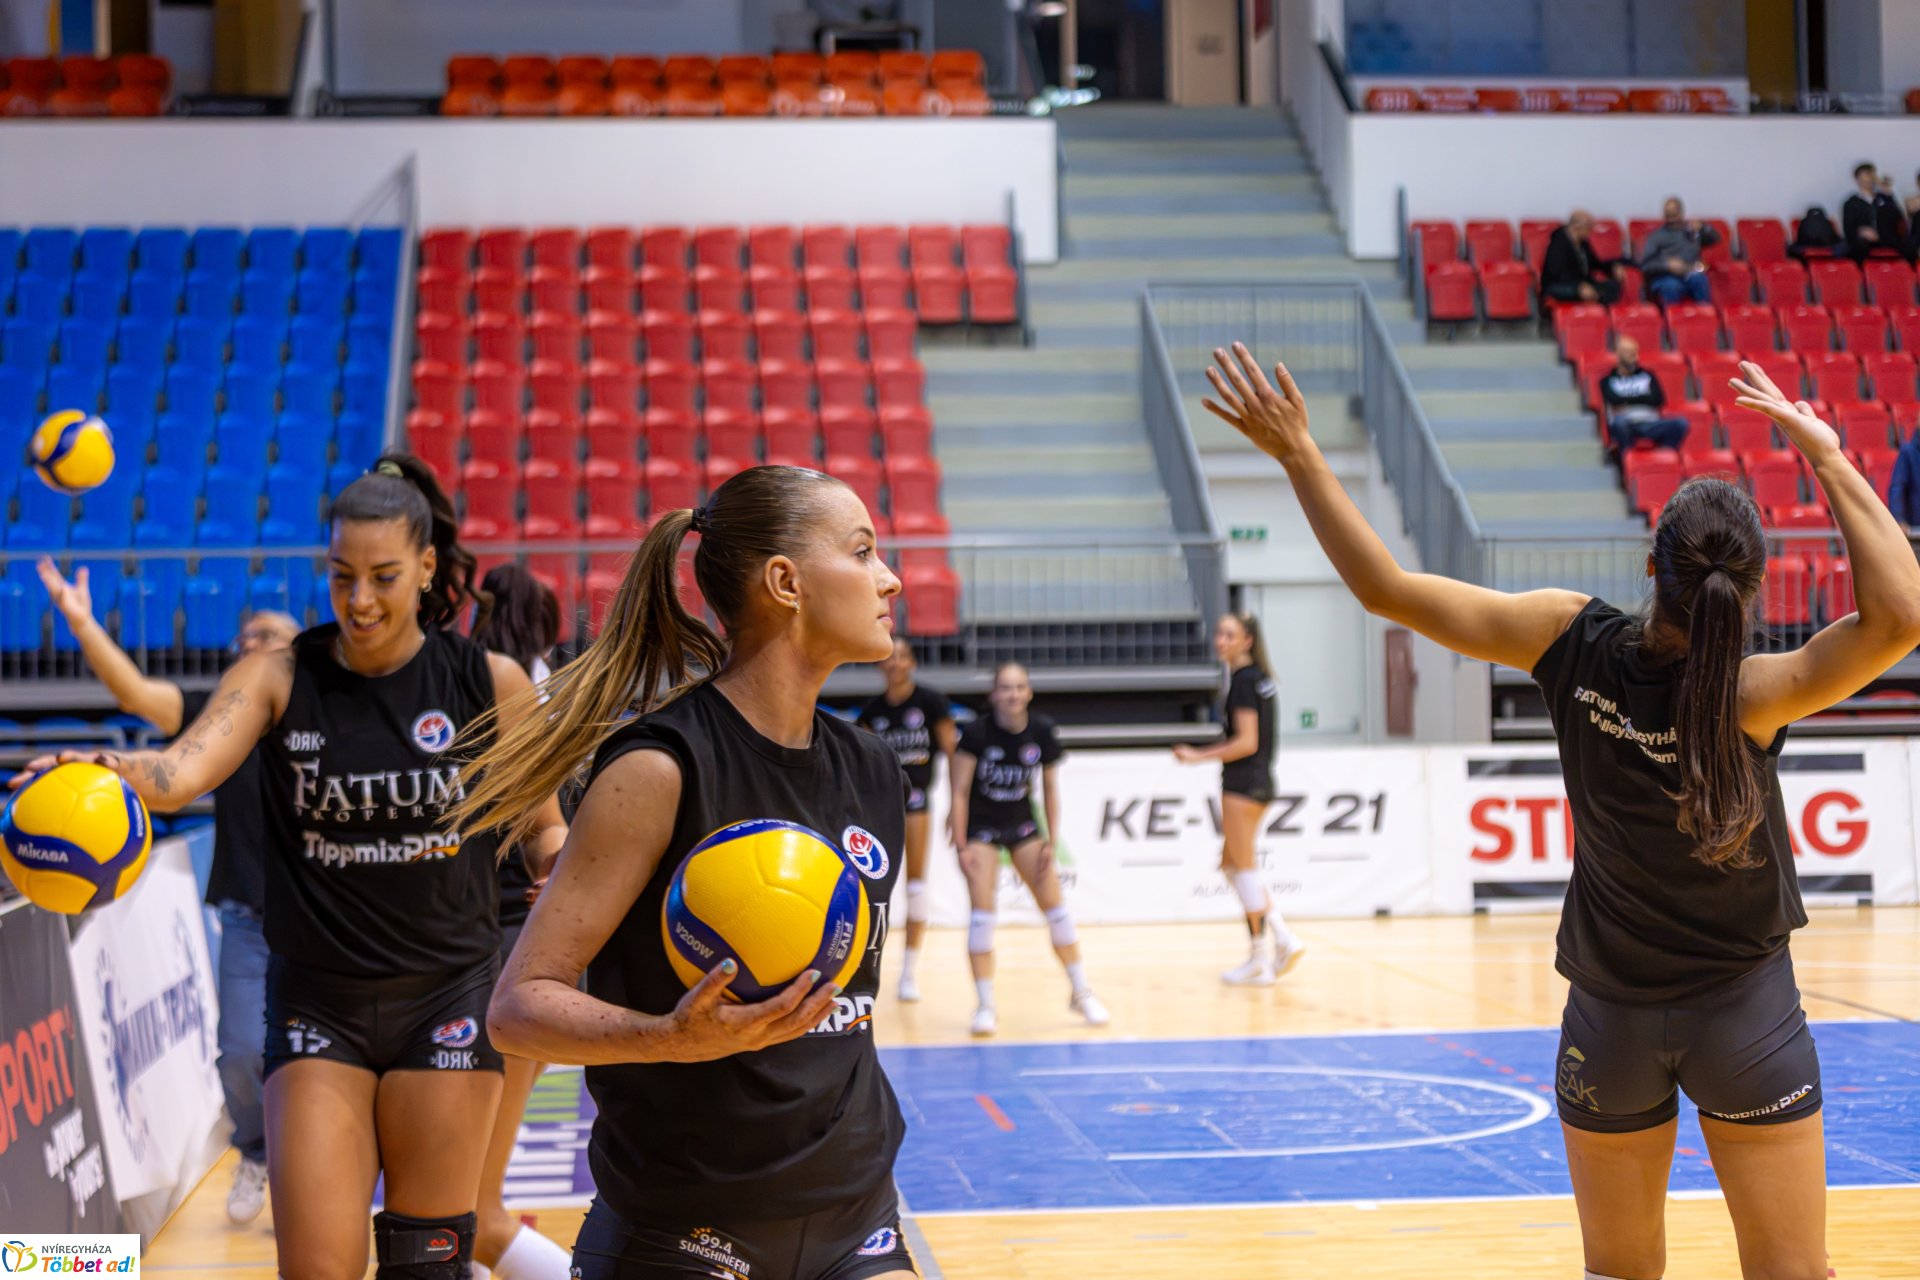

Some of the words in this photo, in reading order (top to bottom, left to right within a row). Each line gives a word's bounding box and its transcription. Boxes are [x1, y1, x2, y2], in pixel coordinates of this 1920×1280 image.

[1573, 685, 1617, 715] FATUM
[290, 758, 466, 812] FATUM
[1323, 790, 1388, 834] 21
[675, 921, 715, 959] V200W
[835, 921, 854, 961] FIVB
[699, 1233, 733, 1255] 99.4
